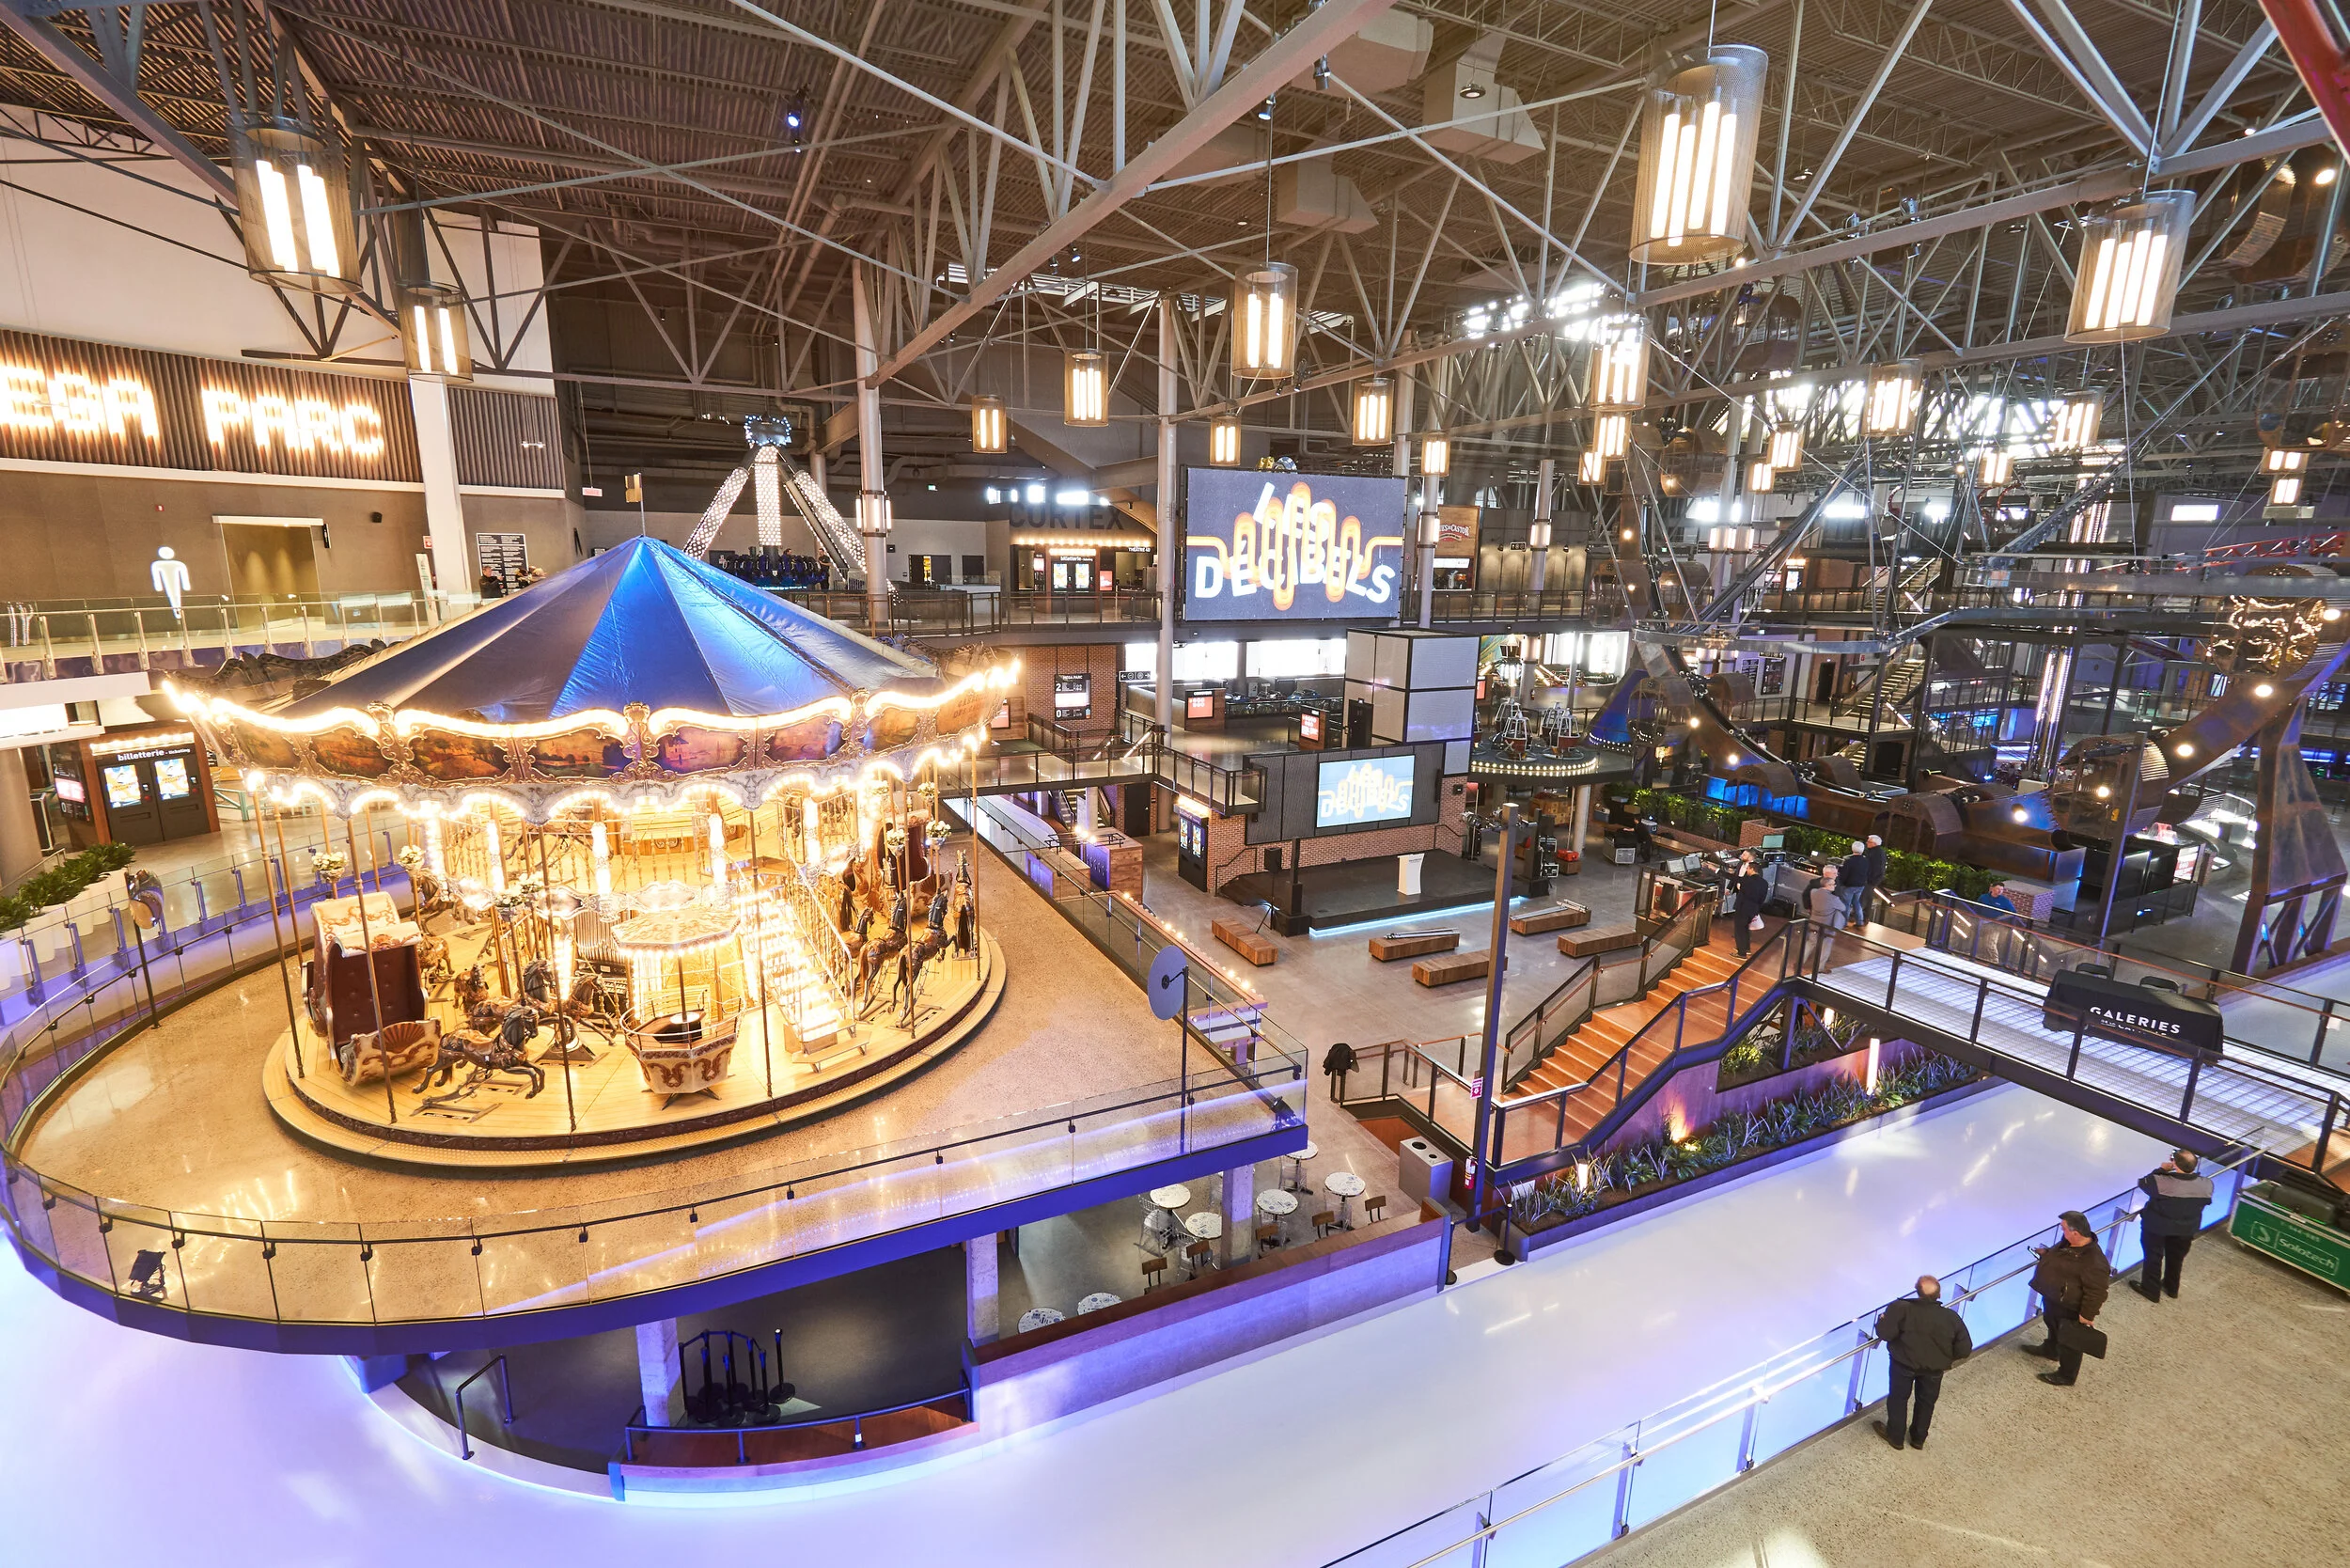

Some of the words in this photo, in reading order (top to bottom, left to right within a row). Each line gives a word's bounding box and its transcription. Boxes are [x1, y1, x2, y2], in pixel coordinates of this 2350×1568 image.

[200, 384, 385, 459] PARC
[1253, 481, 1335, 542] LES
[1195, 540, 1396, 604] DÉCIBELS
[1056, 682, 1061, 692] 2
[118, 748, 164, 761] billetterie
[2090, 1006, 2181, 1035] GALERIES
[2280, 1238, 2335, 1269] Solotech
